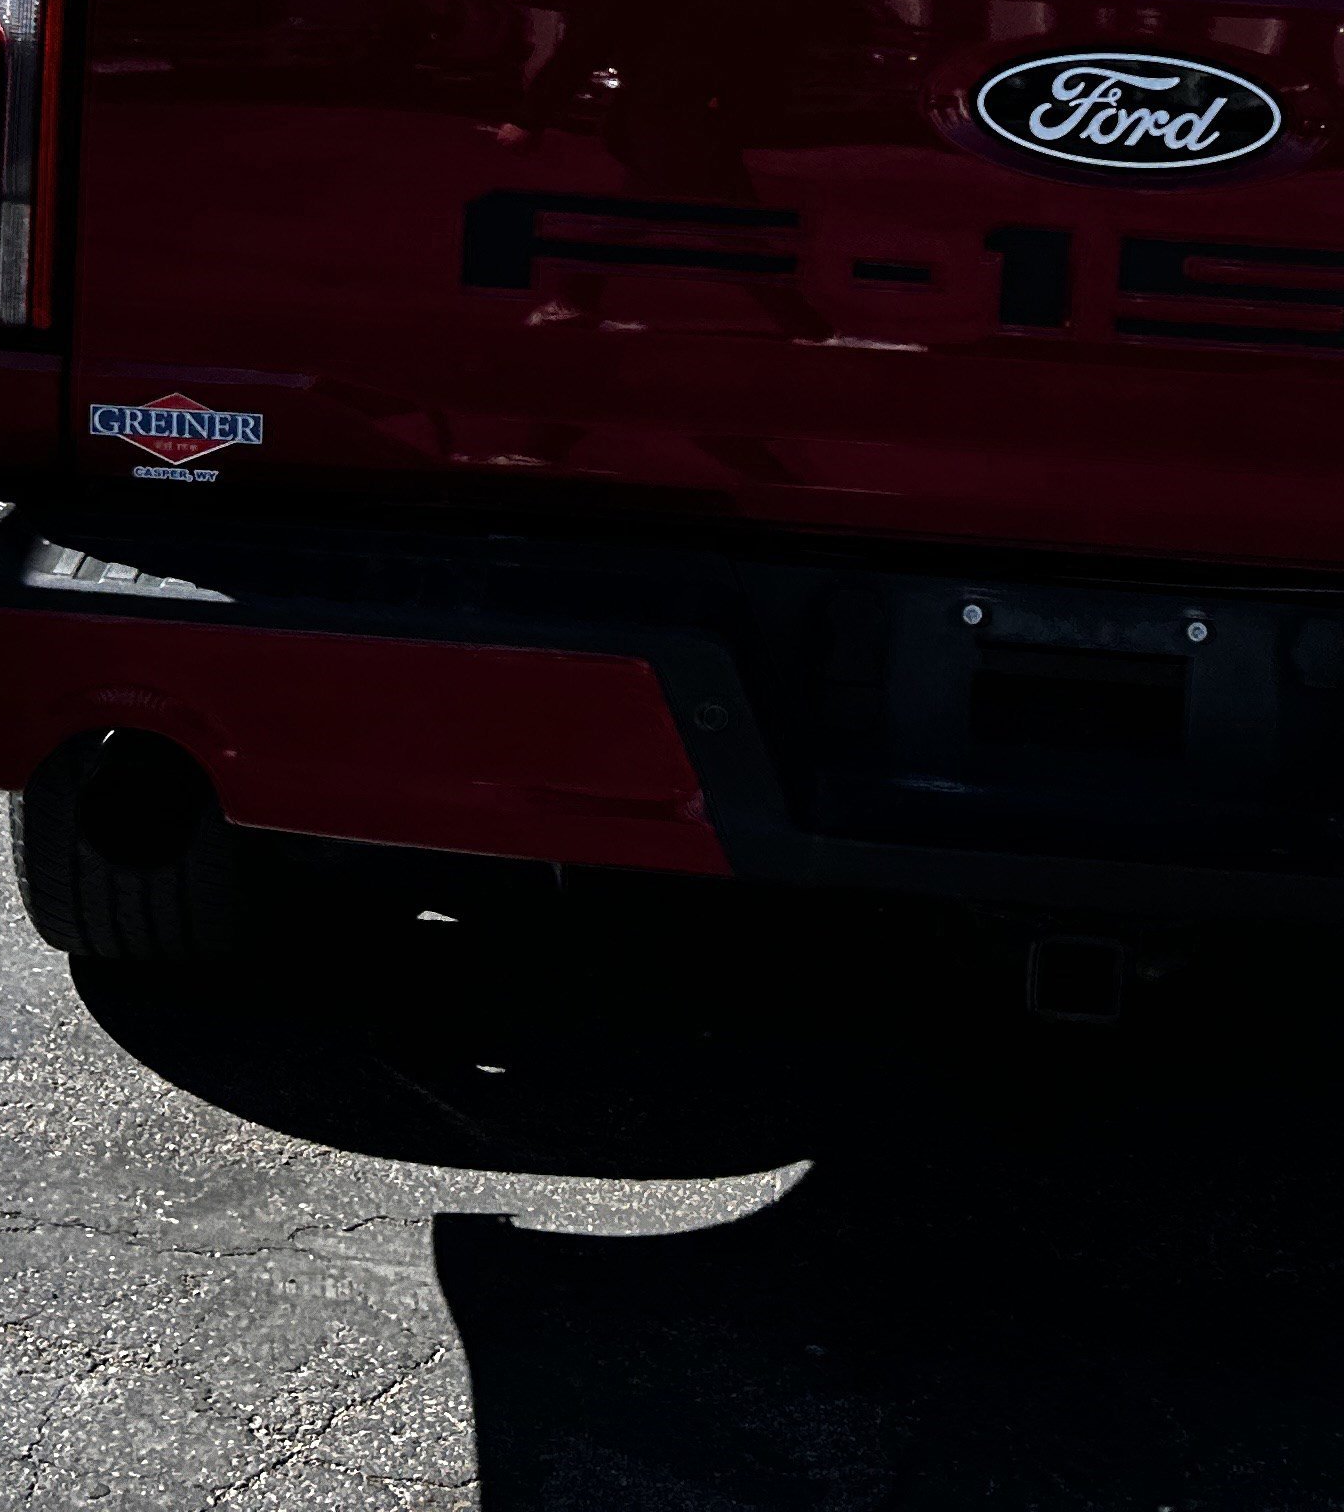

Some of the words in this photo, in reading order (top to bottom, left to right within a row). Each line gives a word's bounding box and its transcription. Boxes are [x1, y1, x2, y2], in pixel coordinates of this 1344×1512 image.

[1029, 66, 1228, 151] Ford
[93, 406, 261, 443] GREINER
[133, 465, 193, 483] CASPER,
[194, 468, 219, 482] WY
